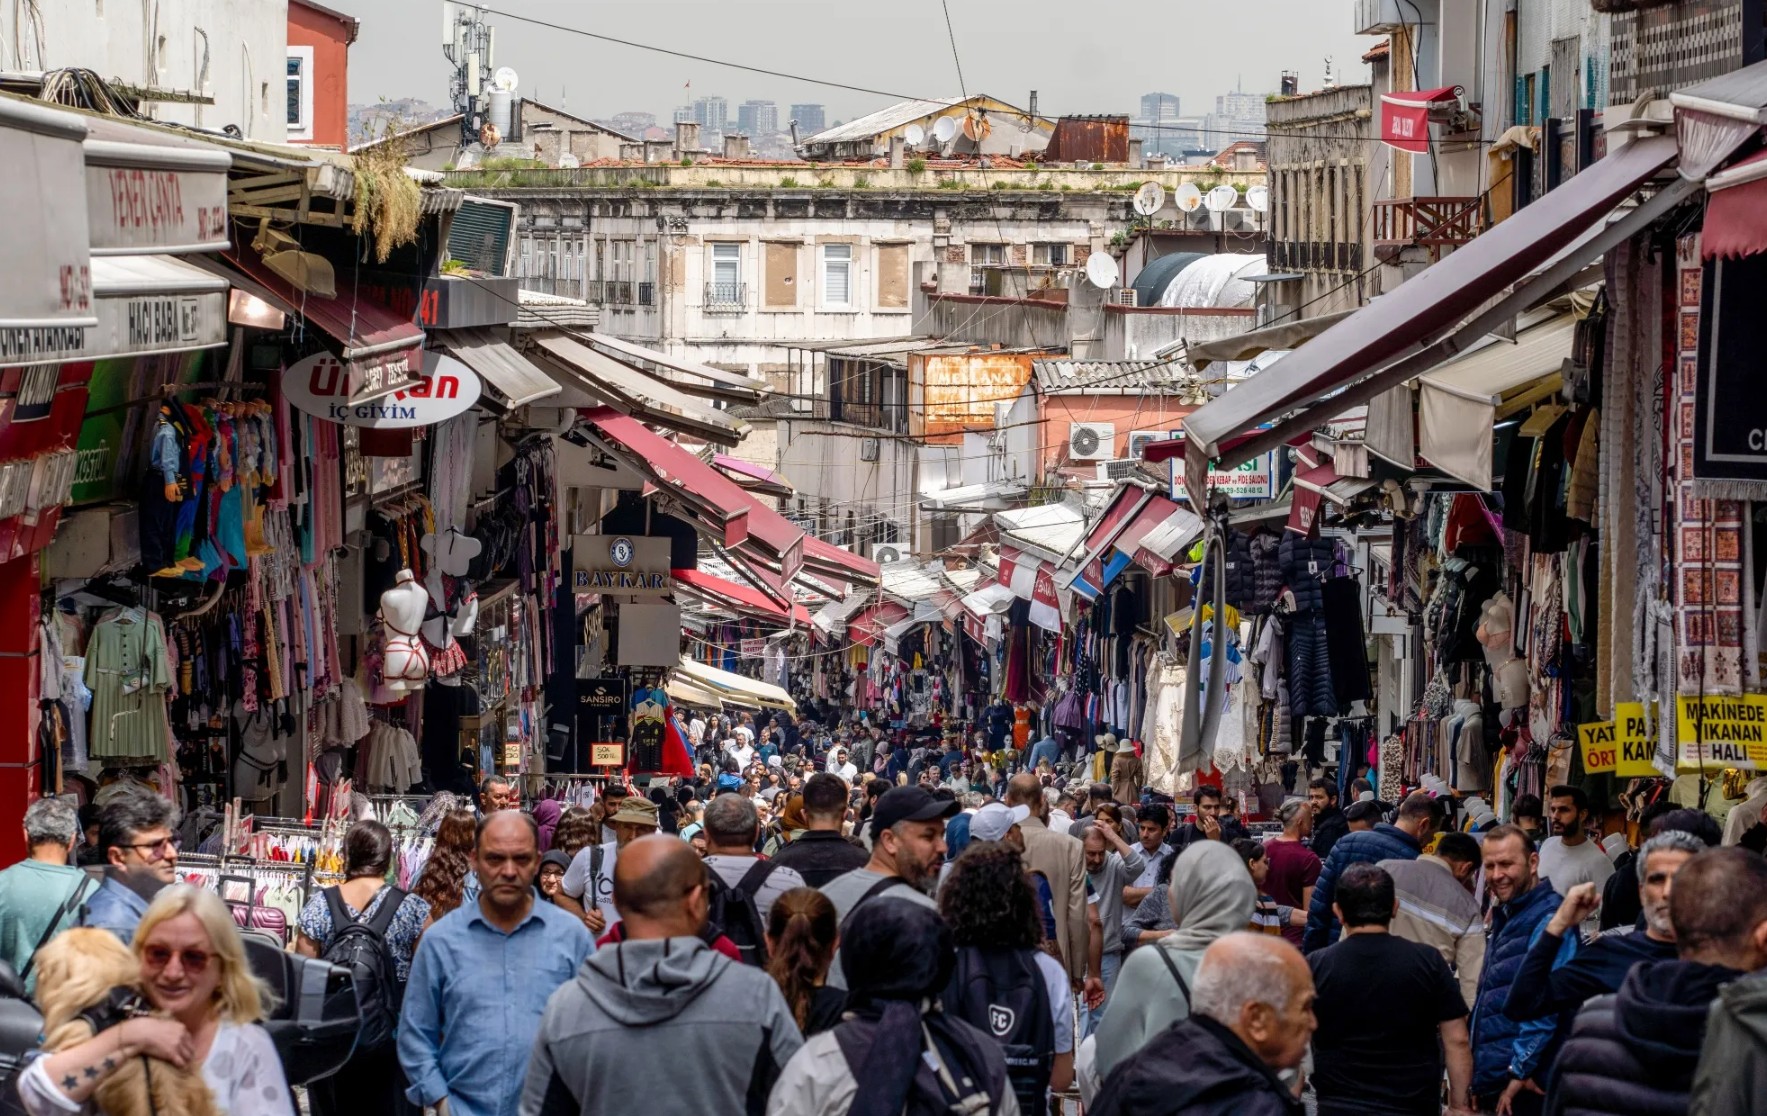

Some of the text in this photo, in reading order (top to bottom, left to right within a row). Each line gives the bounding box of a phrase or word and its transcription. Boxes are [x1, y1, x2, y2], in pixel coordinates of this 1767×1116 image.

[108, 169, 147, 228] YENER
[128, 301, 152, 345] HACI
[155, 300, 179, 343] BABA
[328, 403, 416, 419] İÇ GİYİM
[575, 570, 664, 590] BAYKAR
[580, 695, 621, 704] SANSIRO
[1686, 700, 1766, 722] MAKİNEDE
[1585, 726, 1616, 744] YAT
[1692, 723, 1763, 742] YIKANAN
[1587, 748, 1616, 768] ÖRT
[1712, 743, 1748, 762] HALI
[992, 1010, 1007, 1029] FC
